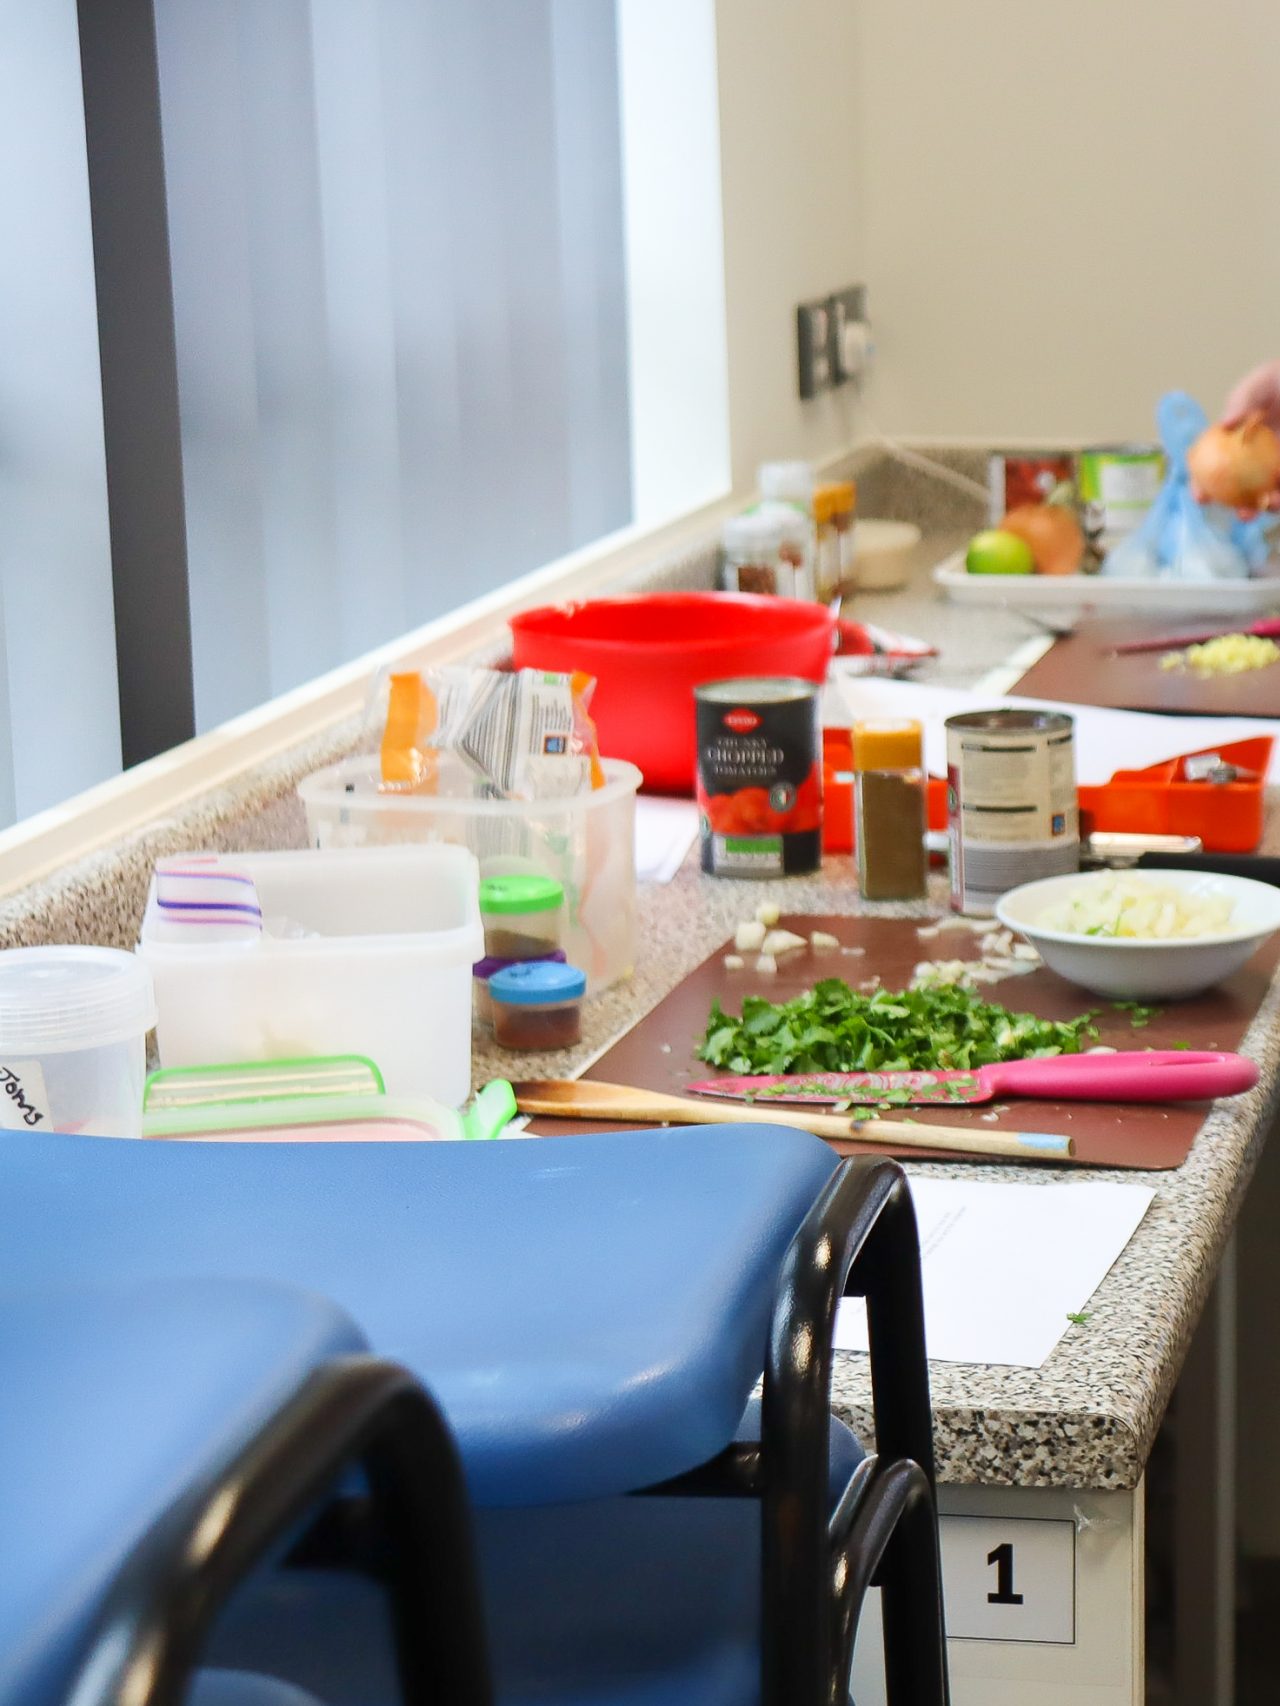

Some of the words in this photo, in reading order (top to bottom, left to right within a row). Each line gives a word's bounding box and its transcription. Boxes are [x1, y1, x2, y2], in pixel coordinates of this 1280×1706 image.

[707, 747, 784, 765] CHOPPED
[715, 765, 777, 776] TOMATOES
[987, 1543, 1024, 1605] 1
